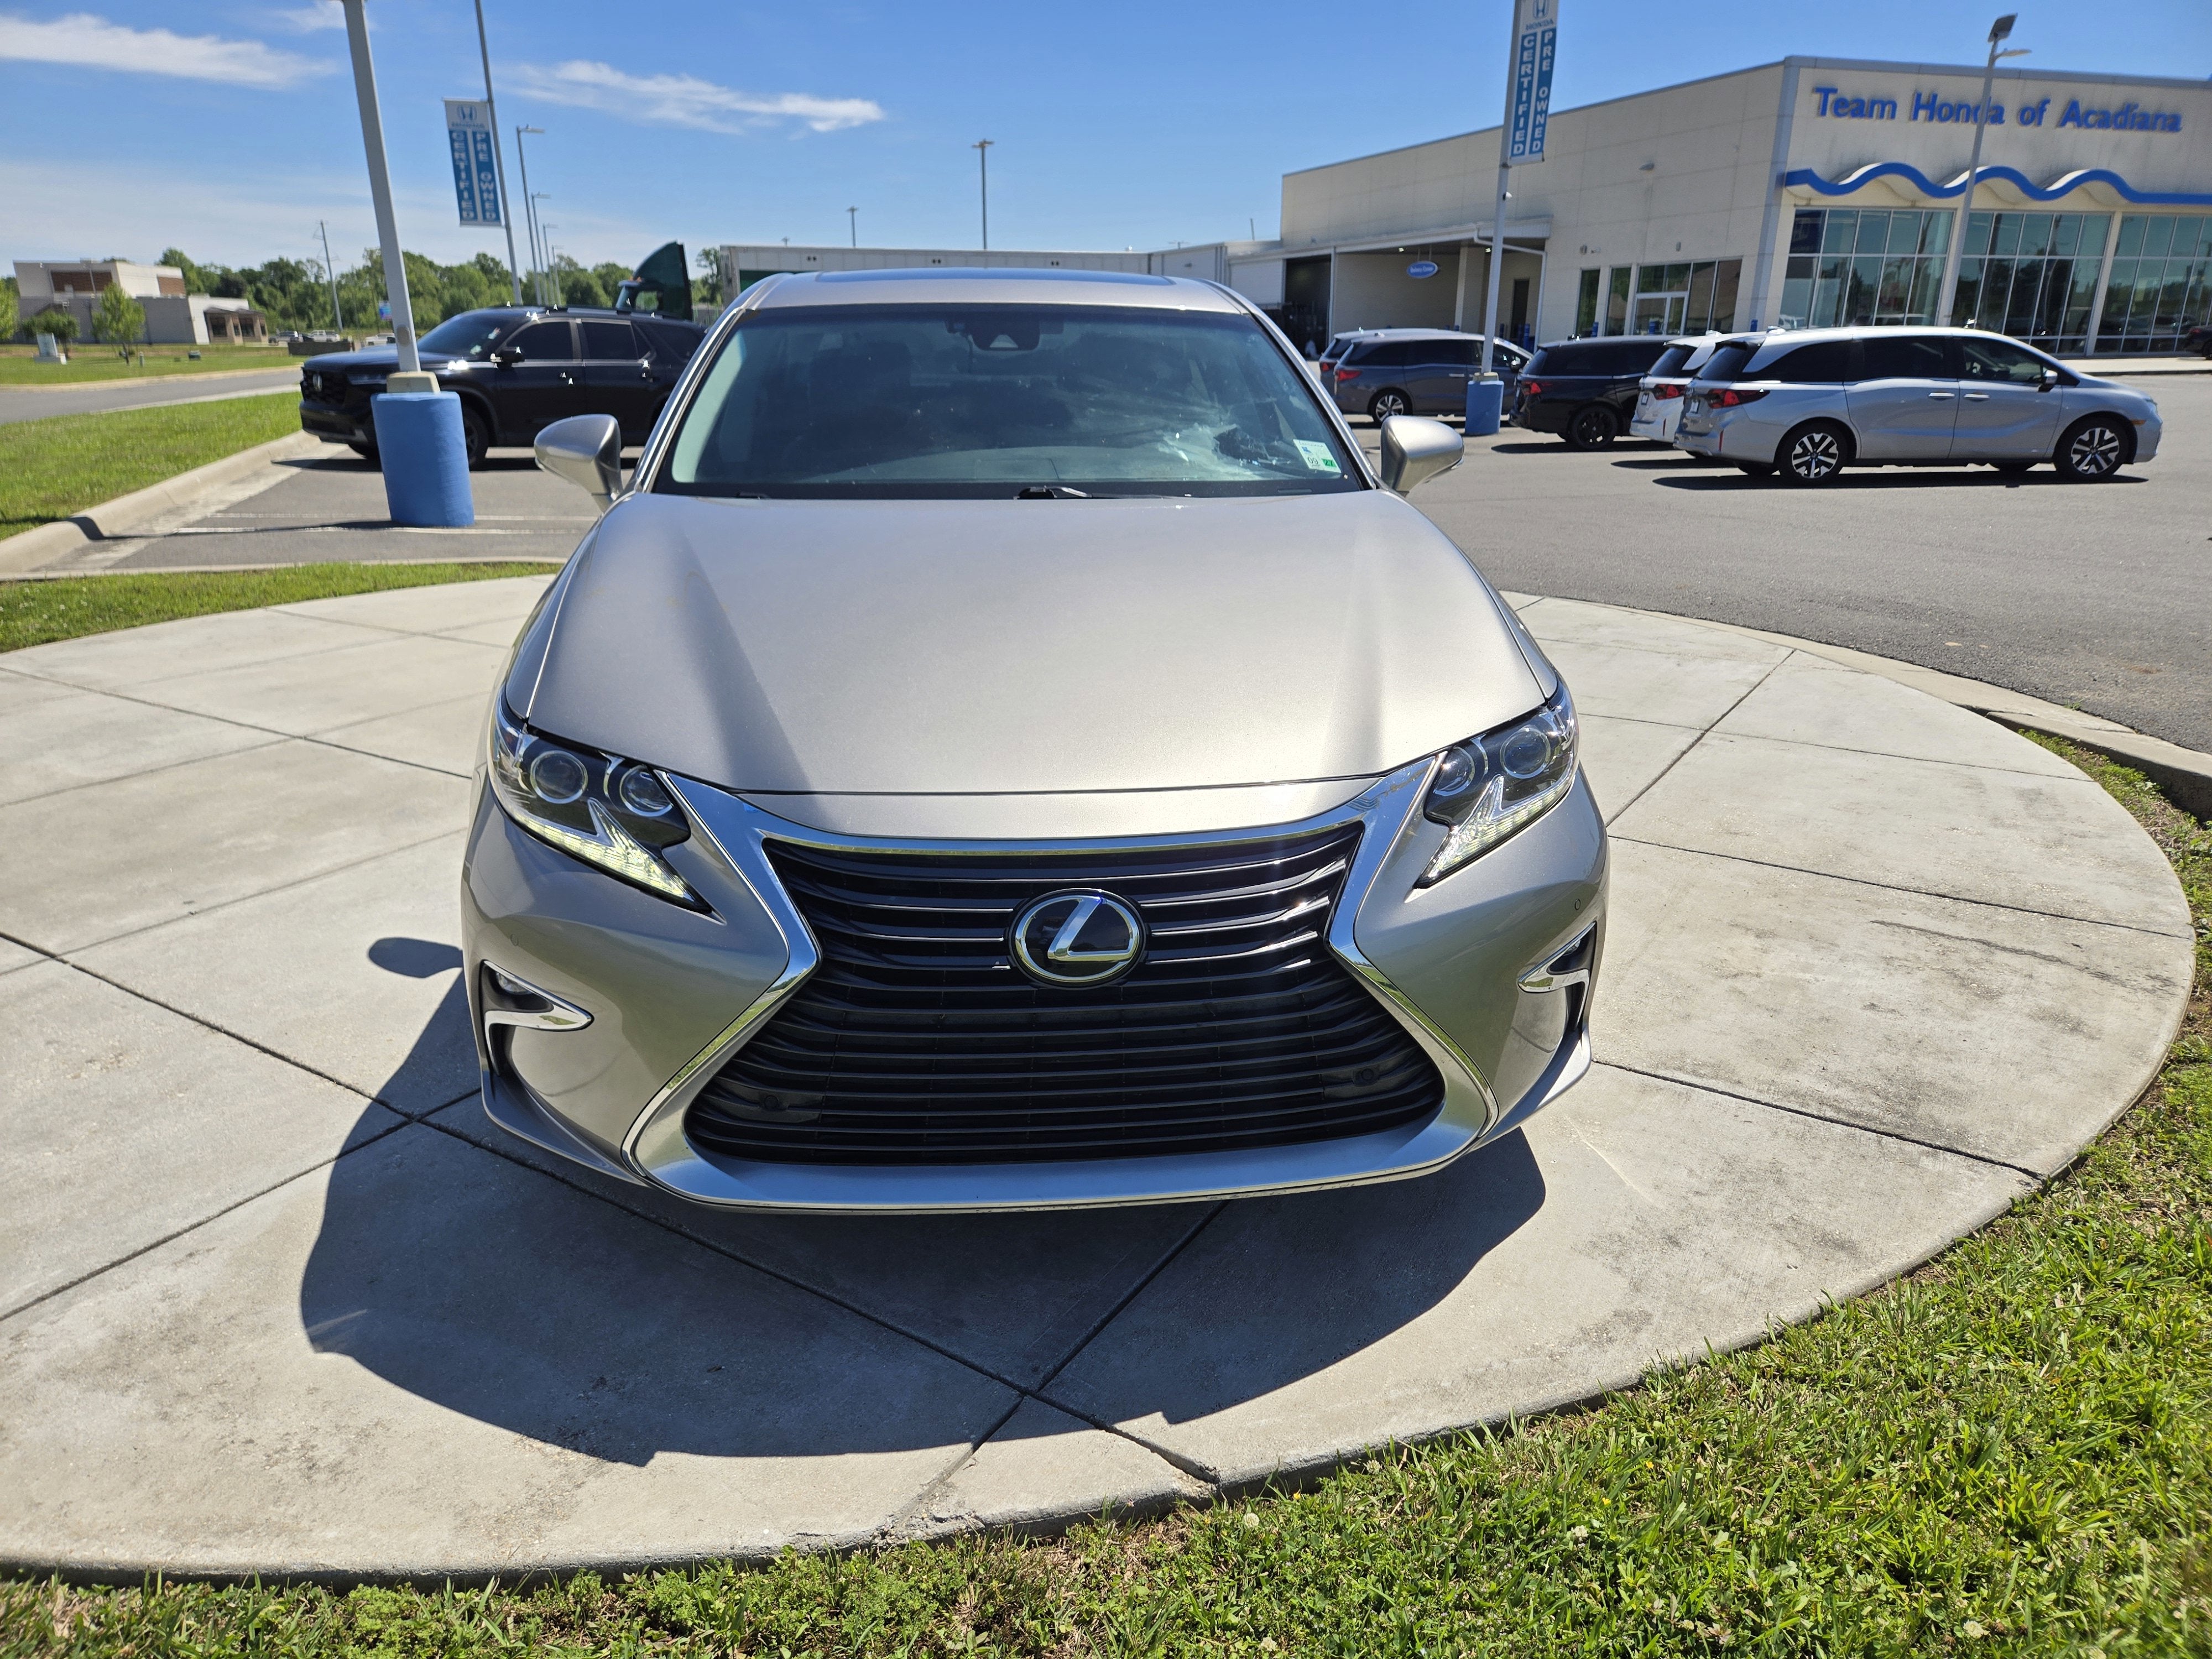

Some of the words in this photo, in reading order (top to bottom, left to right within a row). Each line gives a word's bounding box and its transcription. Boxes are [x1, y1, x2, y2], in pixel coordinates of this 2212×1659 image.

[1542, 31, 1553, 71] PRE
[1513, 35, 1535, 155] CERTIFIED
[1532, 86, 1548, 152] OWNED
[1814, 87, 1898, 119] Team
[1911, 91, 2006, 124] Honda
[2019, 97, 2051, 126] of
[2058, 99, 2182, 132] Acadiana
[477, 132, 489, 162] PRE
[452, 132, 474, 220] CERTIFIED
[480, 172, 497, 220] OWNED
